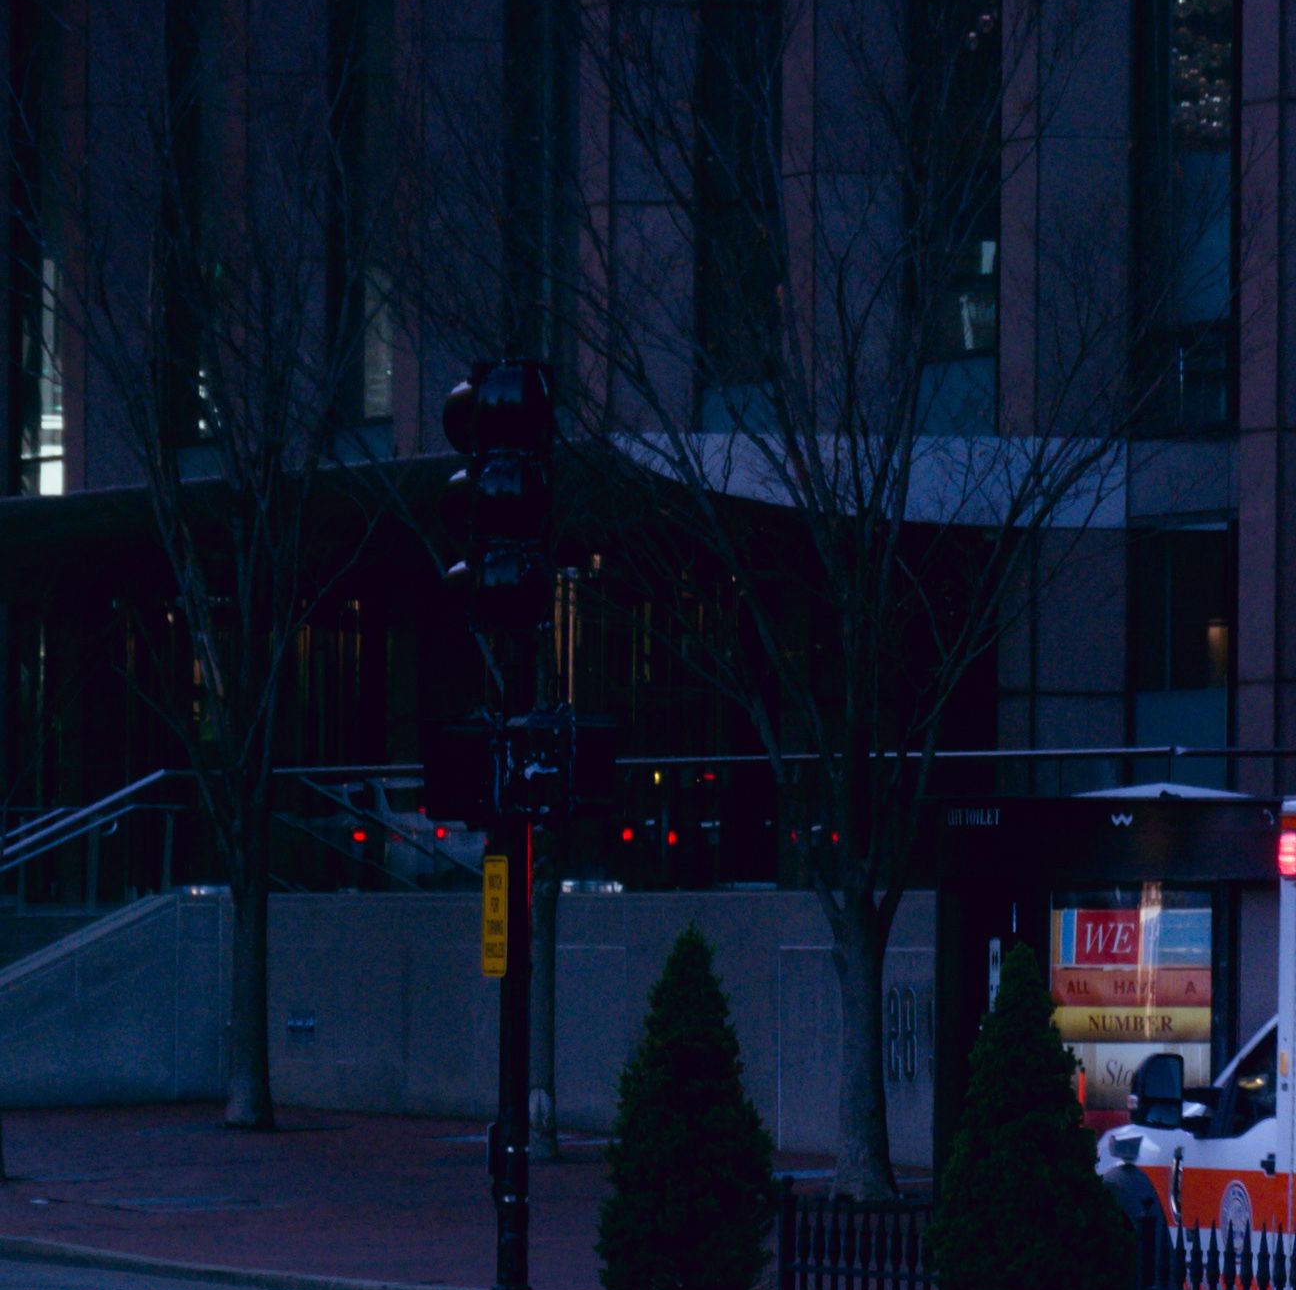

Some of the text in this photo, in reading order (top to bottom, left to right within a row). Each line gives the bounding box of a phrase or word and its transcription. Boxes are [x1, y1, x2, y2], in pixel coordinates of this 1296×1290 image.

[1083, 921, 1136, 955] WE
[1066, 980, 1090, 995] ALL
[1184, 980, 1197, 995] A
